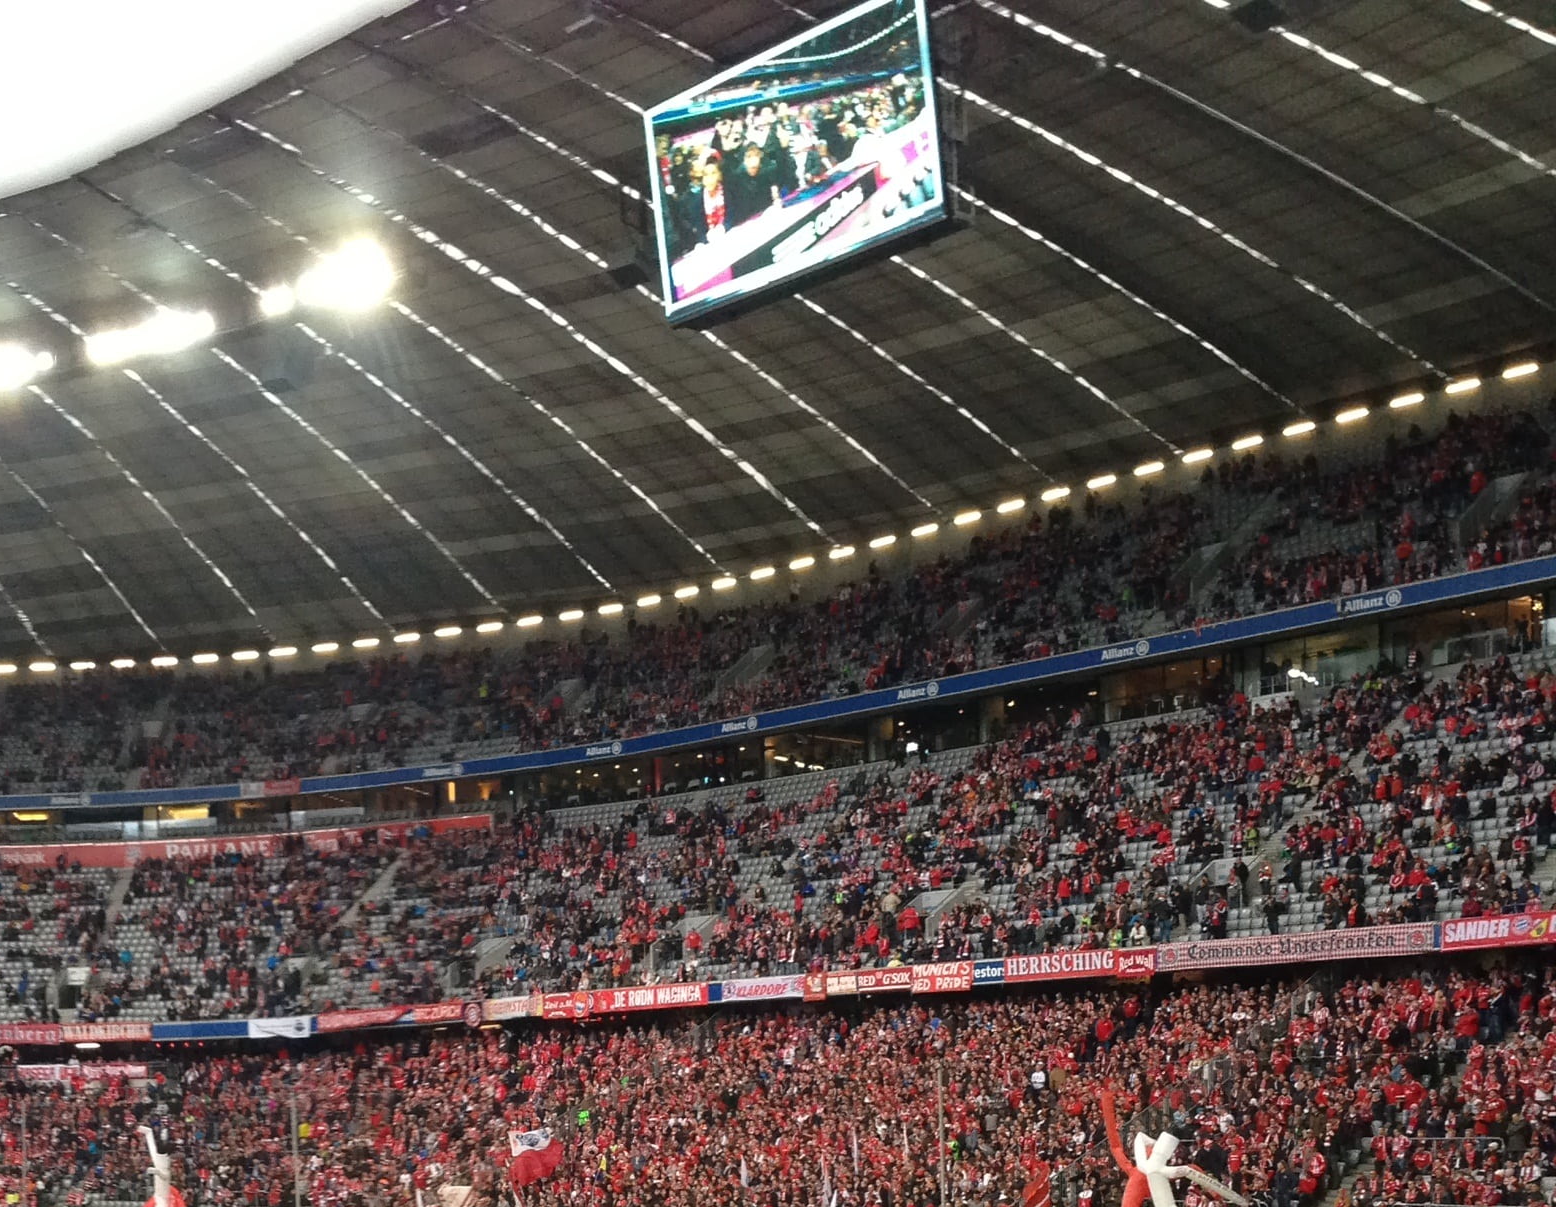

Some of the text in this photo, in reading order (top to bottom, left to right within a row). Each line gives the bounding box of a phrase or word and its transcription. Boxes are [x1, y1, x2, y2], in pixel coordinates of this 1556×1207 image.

[1344, 595, 1383, 612] Allianz
[1101, 645, 1135, 661] Allianz
[897, 687, 926, 700] Allianz
[166, 840, 271, 860] PAULANE
[1445, 919, 1510, 942] SANDER
[1187, 943, 1272, 961] Commando
[1007, 951, 1114, 977] HERRSCHING
[859, 974, 875, 986] RED
